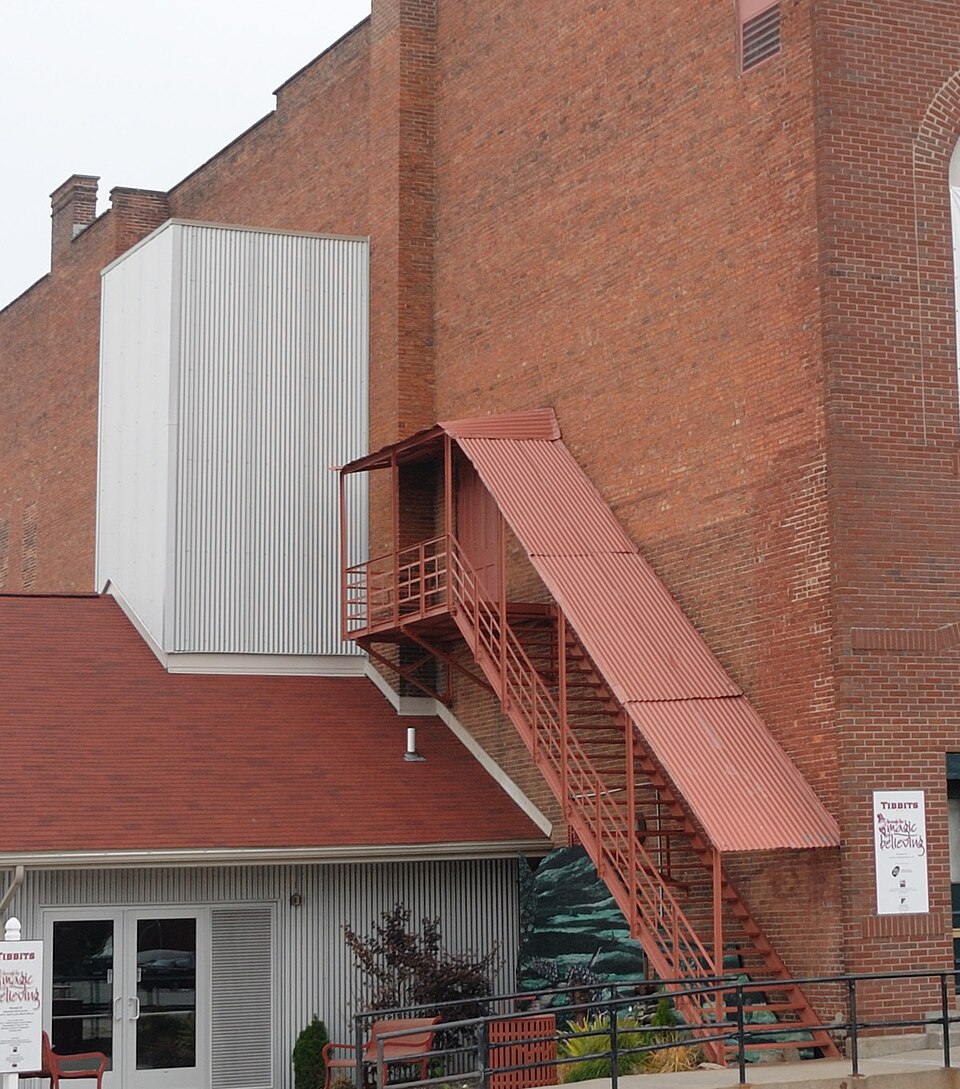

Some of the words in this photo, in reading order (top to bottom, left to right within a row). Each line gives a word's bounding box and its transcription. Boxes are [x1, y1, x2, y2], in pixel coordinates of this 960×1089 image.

[881, 801, 919, 809] TIBBITS
[887, 820, 918, 839] magic
[880, 834, 925, 856] believing
[0, 987, 41, 1010] elieving
